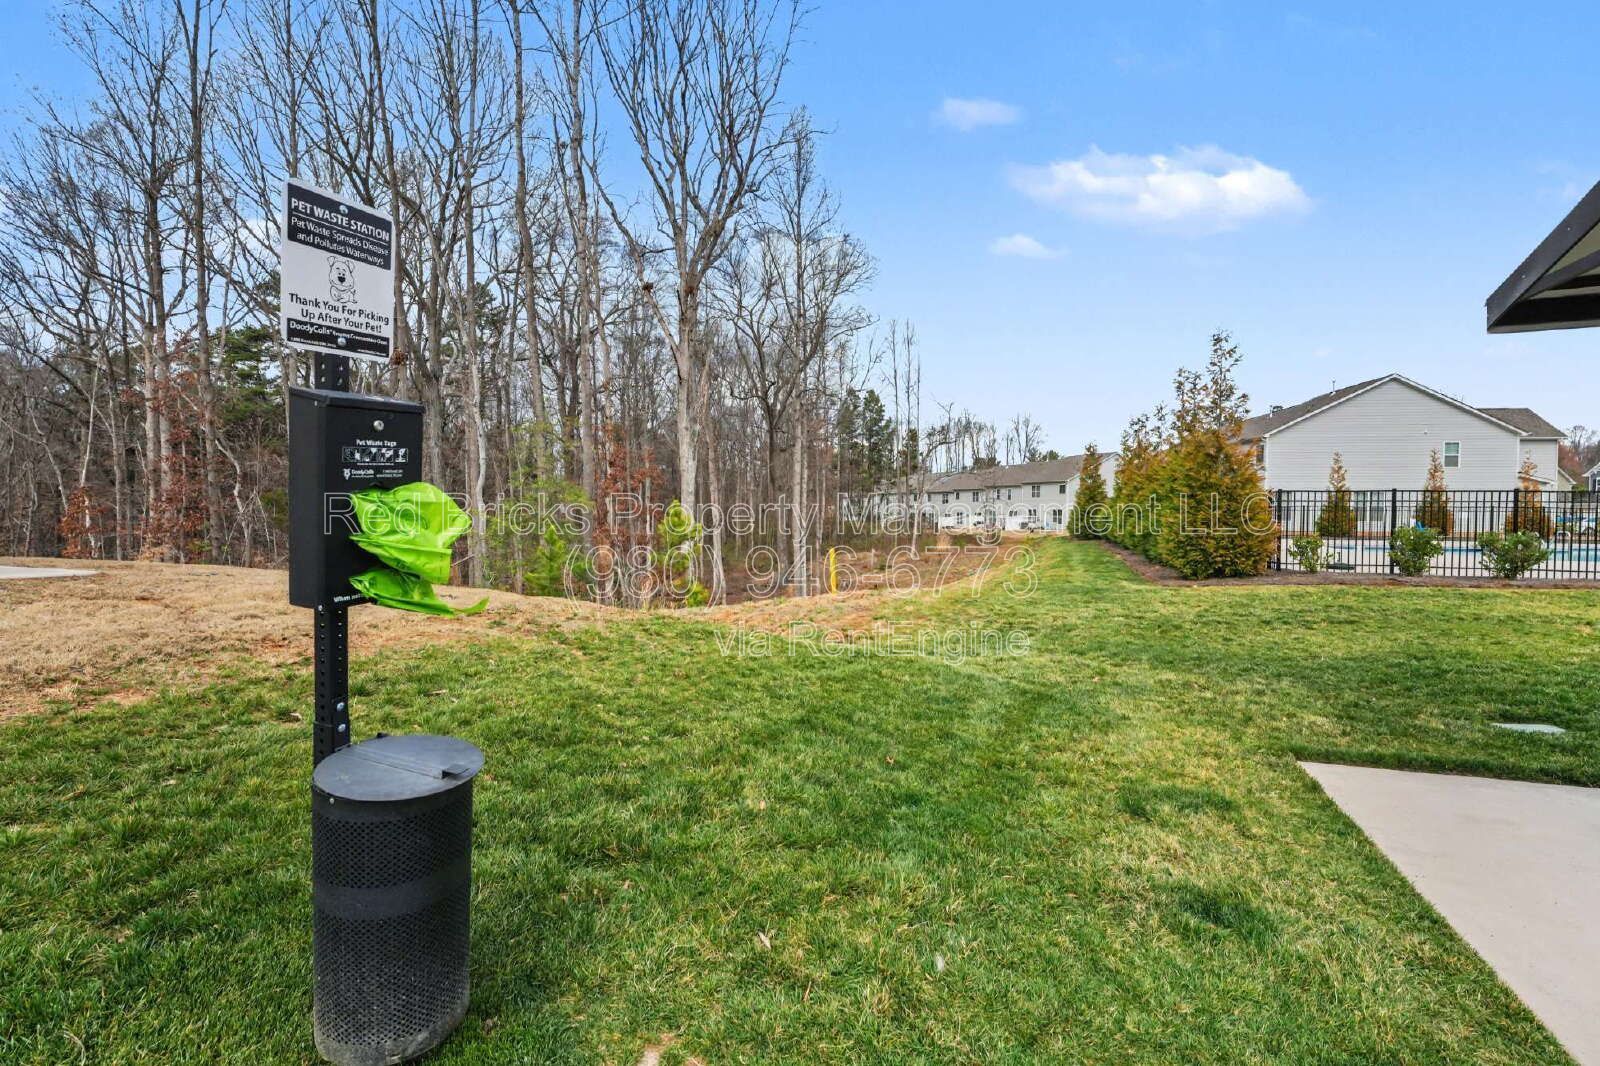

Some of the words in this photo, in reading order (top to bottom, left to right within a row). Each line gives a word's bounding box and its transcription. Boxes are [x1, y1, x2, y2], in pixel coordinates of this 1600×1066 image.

[291, 198, 313, 214] PET
[313, 205, 349, 227] WASTE
[350, 221, 390, 241] STATION
[291, 216, 306, 229] Pet
[306, 221, 331, 237] Waste
[332, 230, 362, 247] Spreads
[363, 241, 389, 256] Disease
[296, 232, 313, 243] and
[314, 236, 345, 254] Pollutes
[345, 246, 384, 265] Waterways
[289, 292, 321, 309] Thank
[323, 300, 340, 313] You
[341, 305, 357, 317] For
[358, 309, 390, 326] Picking
[301, 308, 316, 321] Up
[317, 312, 342, 325] After
[343, 317, 364, 329] Your
[365, 322, 382, 334] Pet!
